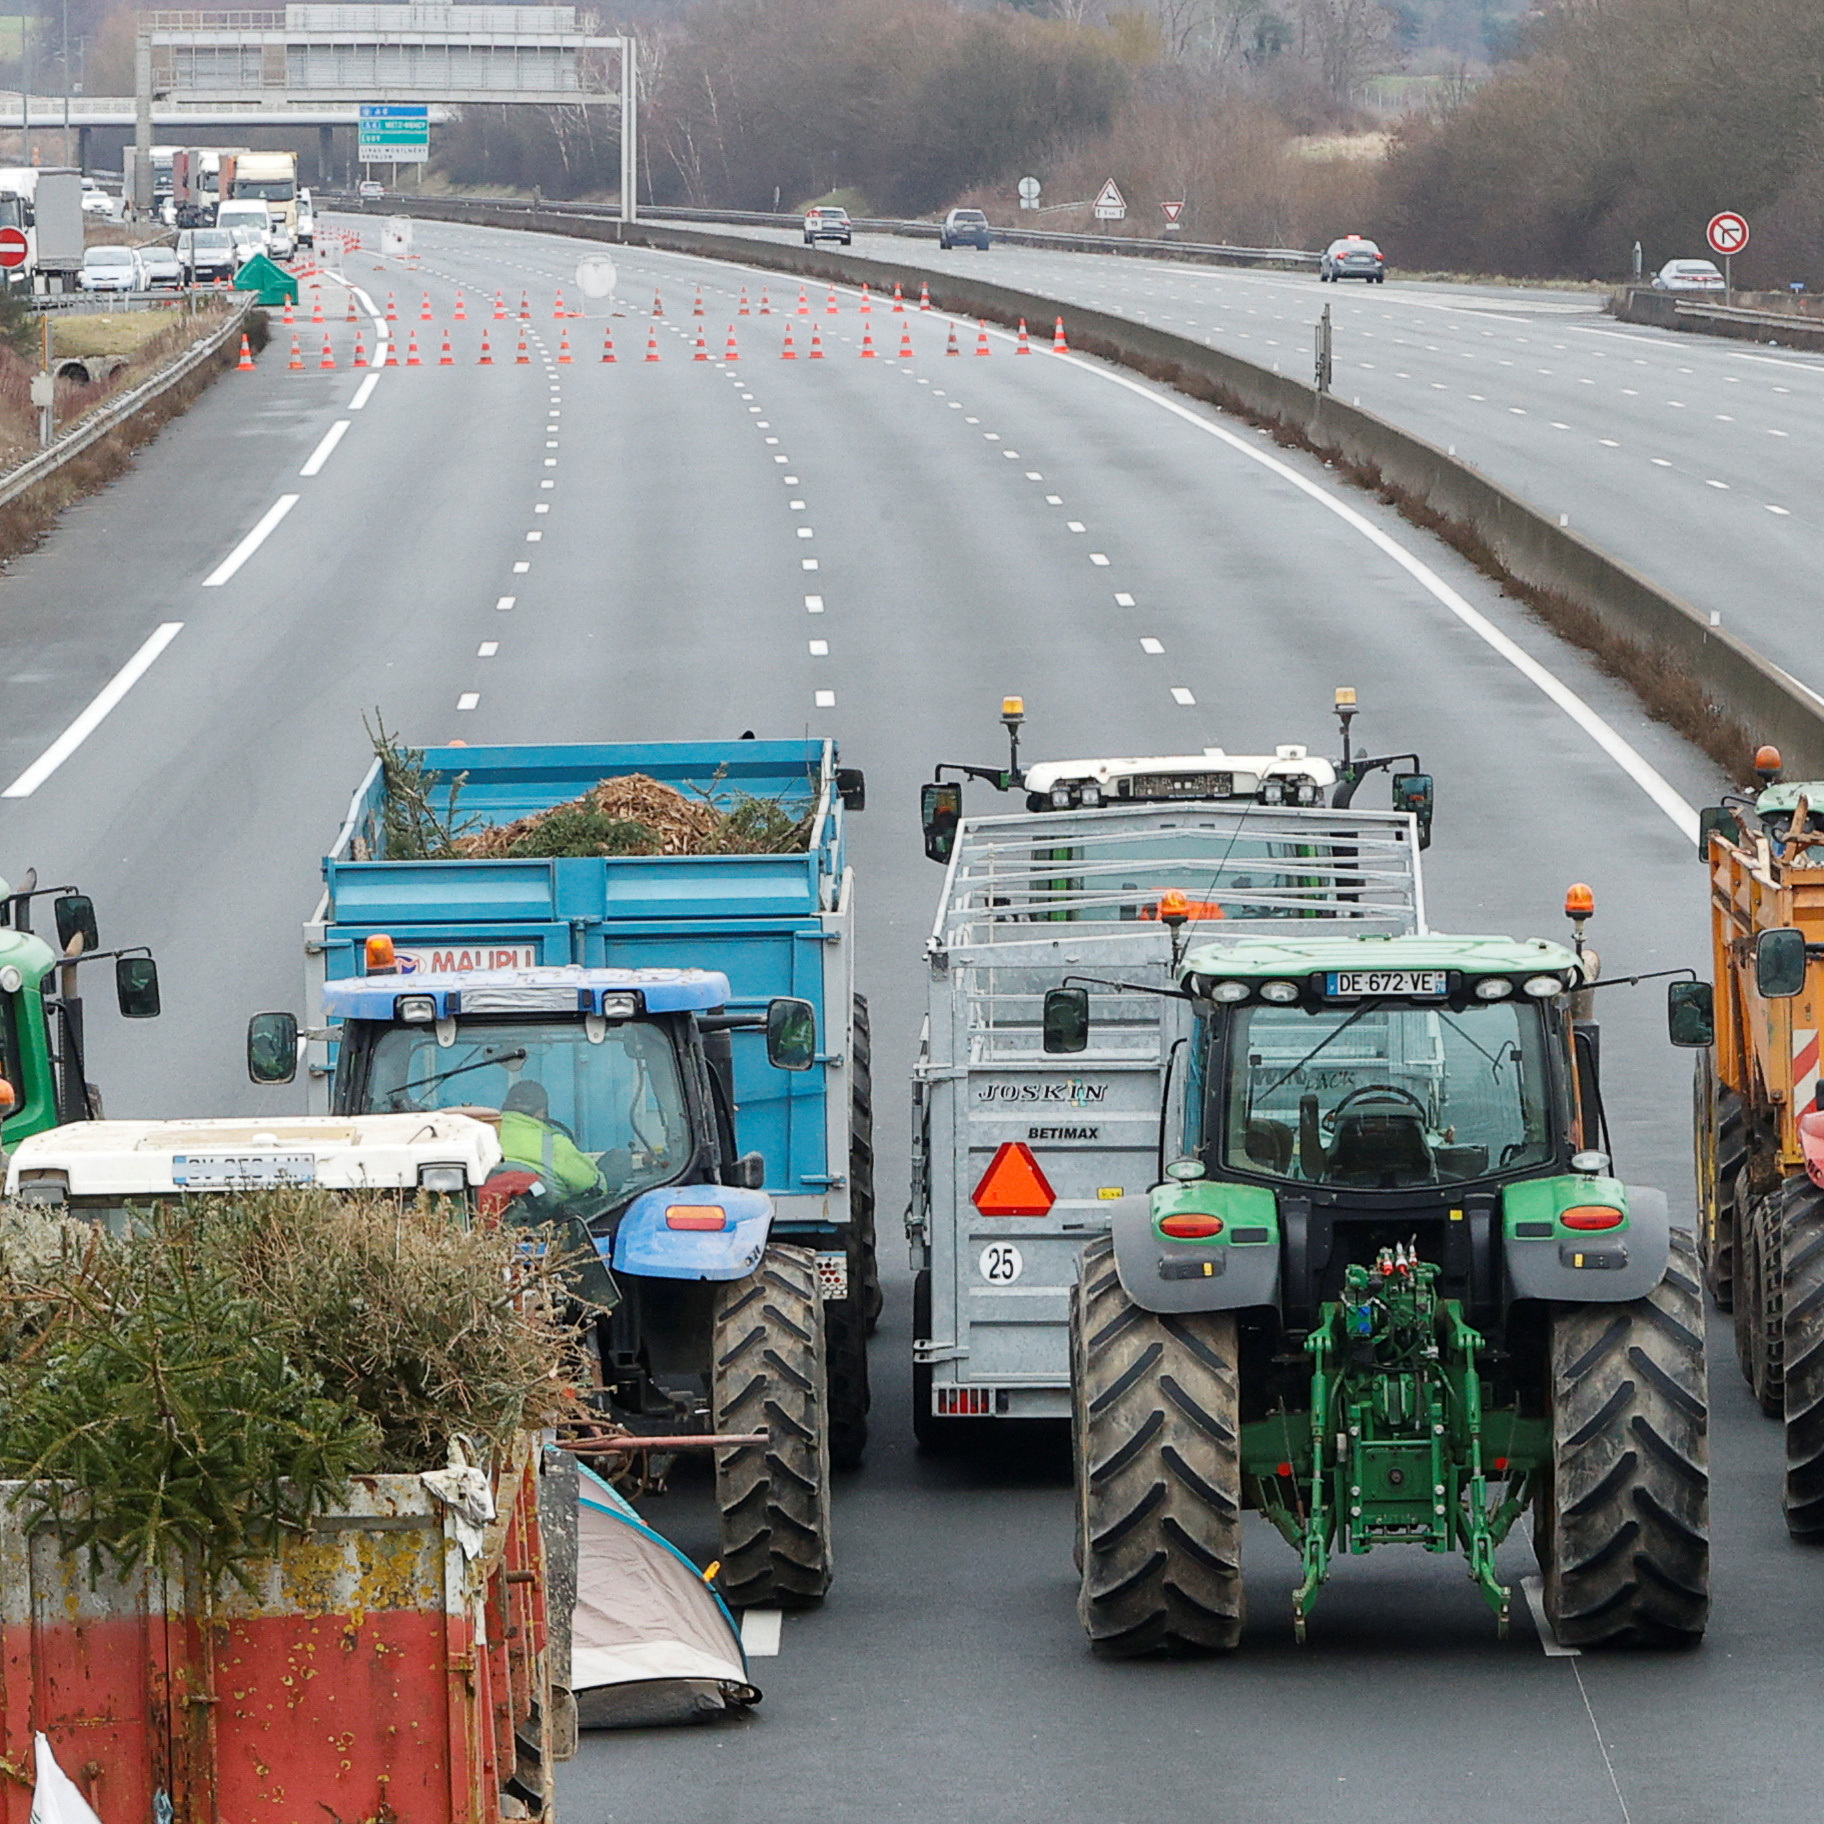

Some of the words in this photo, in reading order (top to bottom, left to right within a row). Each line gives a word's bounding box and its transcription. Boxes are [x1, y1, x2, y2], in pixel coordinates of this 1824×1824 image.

[978, 1083, 1108, 1101] JOSKIN
[1028, 1127, 1098, 1139] BETIMAX
[989, 1249, 1014, 1279] 25
